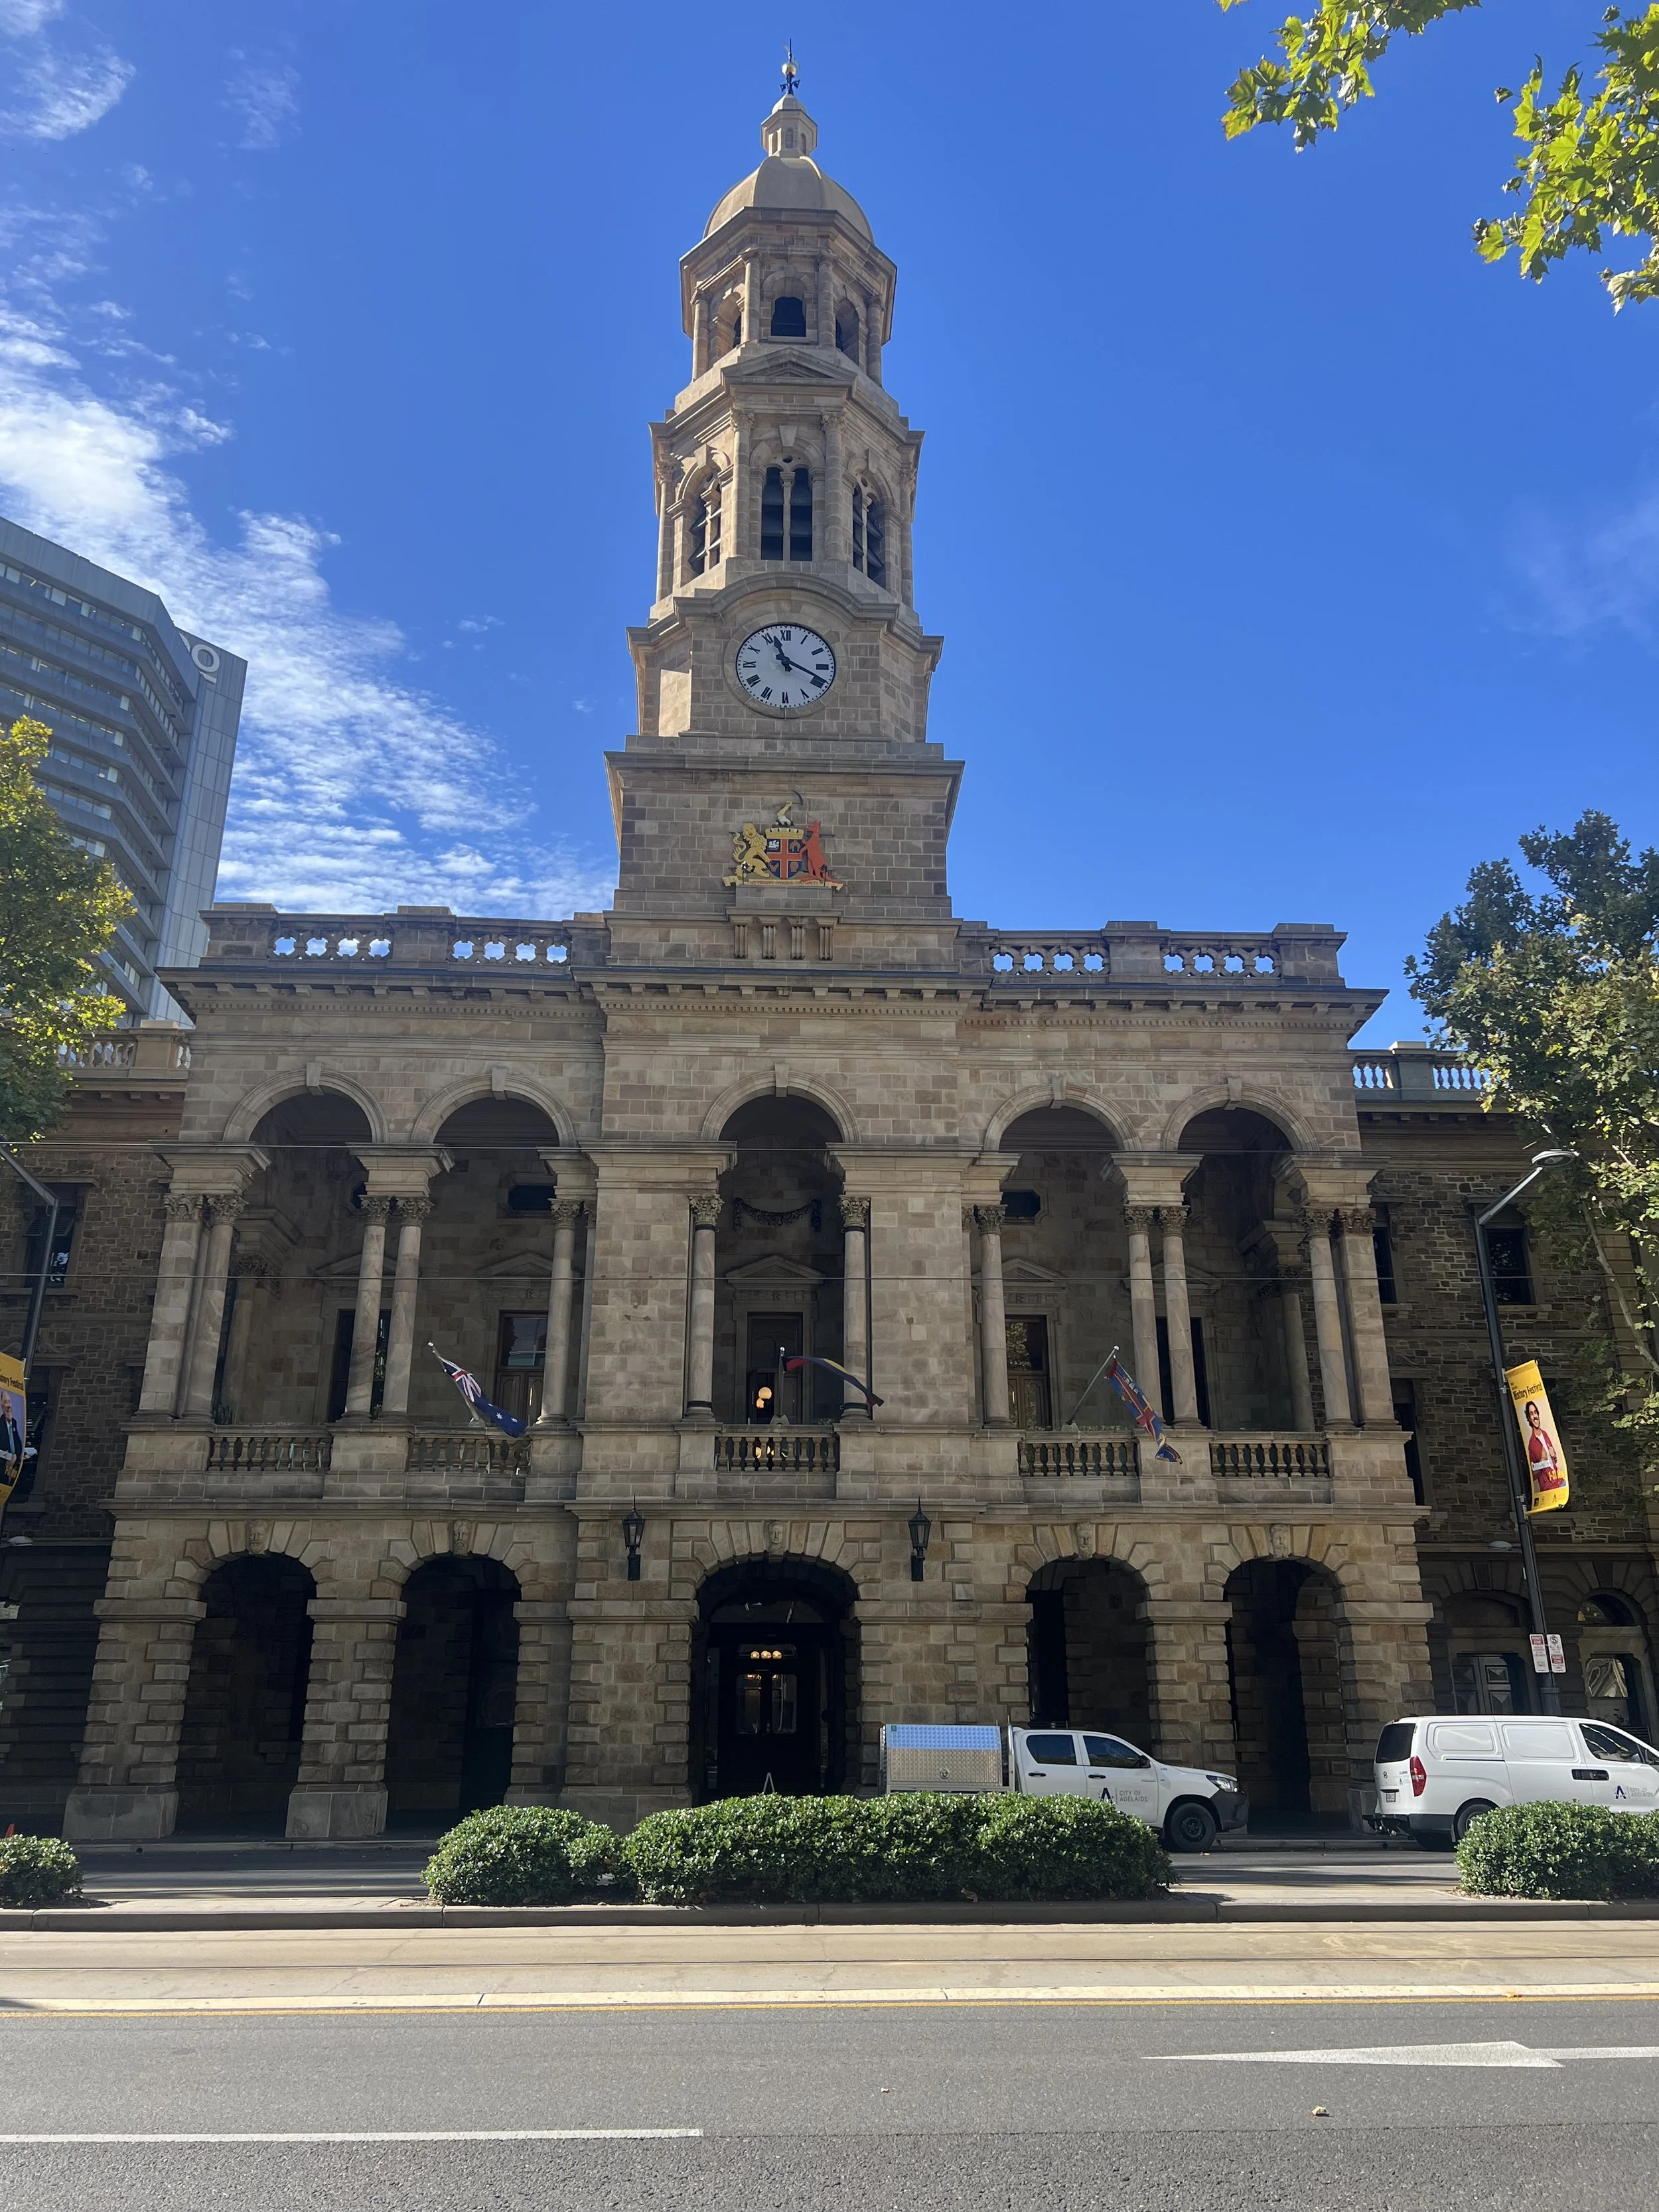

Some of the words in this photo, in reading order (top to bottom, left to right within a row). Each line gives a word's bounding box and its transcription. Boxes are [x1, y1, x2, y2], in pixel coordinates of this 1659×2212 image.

[761, 632, 773, 645] XI
[780, 630, 790, 641] XII
[747, 645, 760, 654] X
[1512, 1389, 1528, 1400] History
[1527, 1381, 1542, 1394] Festival
